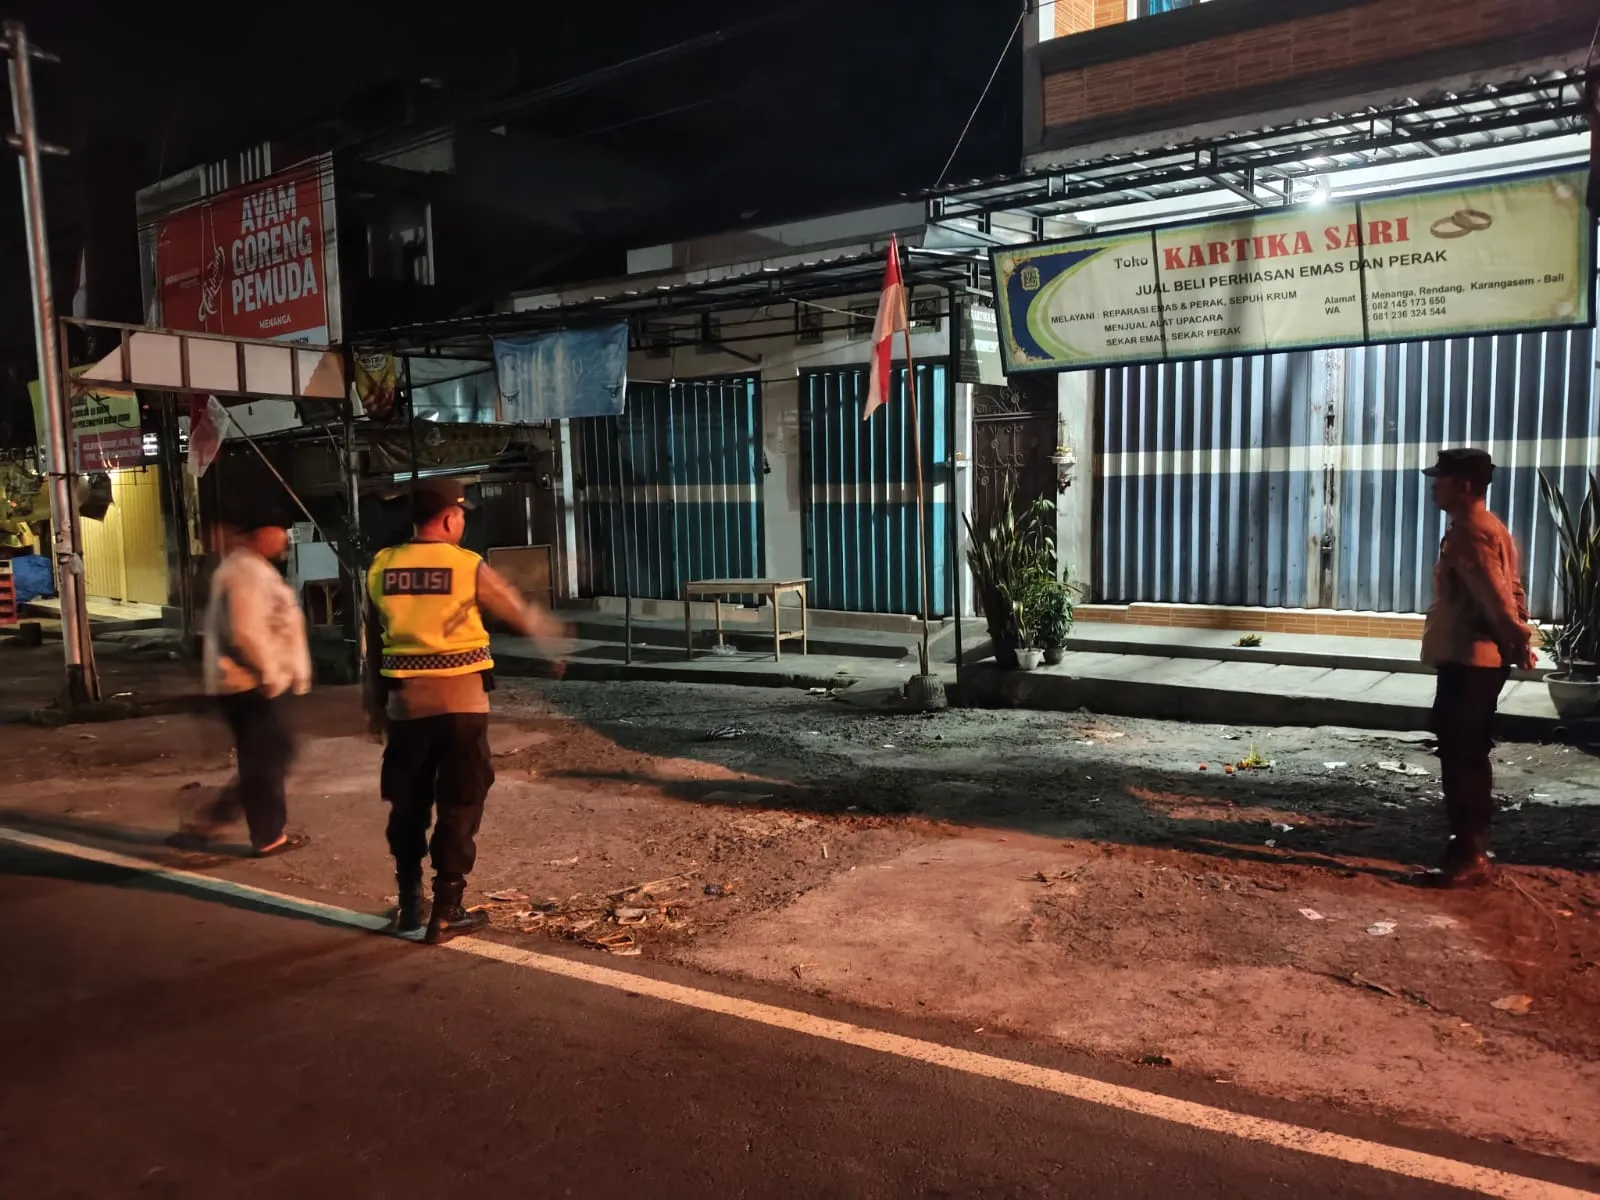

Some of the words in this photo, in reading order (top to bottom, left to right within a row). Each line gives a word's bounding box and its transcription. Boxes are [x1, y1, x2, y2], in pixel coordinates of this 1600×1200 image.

[240, 181, 297, 235] AYAM
[231, 216, 312, 276] GORENG
[1163, 231, 1313, 270] KARTIKA
[1324, 216, 1410, 251] SARI
[1114, 256, 1148, 269] Toko
[1136, 282, 1170, 296] JUAL
[1174, 278, 1206, 292] BELI
[1209, 267, 1295, 288] PERHIASAN
[1300, 262, 1344, 279] EMAS
[1349, 257, 1383, 272] DAN
[1389, 249, 1447, 268] PERAK
[231, 257, 318, 315] PEMUDA
[1324, 294, 1356, 305] Alamat
[1371, 290, 1417, 301] Menanga,
[1419, 284, 1465, 296] Rendang,
[1470, 278, 1535, 291] Karangasem
[1544, 273, 1564, 284] Bali
[1051, 312, 1095, 324] MELAYANI
[1102, 306, 1149, 319] REPARASI
[1151, 303, 1178, 314] EMAS
[1180, 301, 1188, 311] &
[1190, 298, 1226, 310] PERAK,
[1229, 294, 1264, 306] SEPUH
[1266, 290, 1297, 302] KRUM
[1104, 320, 1148, 333] MENJUAL
[1149, 318, 1173, 329] ALAT
[1176, 313, 1223, 325] UPACARA
[1324, 306, 1341, 316] WA
[1371, 301, 1389, 311] 082
[1391, 299, 1408, 309] 145
[1411, 298, 1427, 308] 173
[1372, 312, 1389, 322] 081
[1411, 308, 1427, 318] 324
[1429, 306, 1446, 316] 544
[1106, 337, 1138, 347] SEKAR
[1171, 330, 1205, 341] SEKAR
[1207, 326, 1241, 337] PERAK
[385, 570, 450, 591] POLISI
